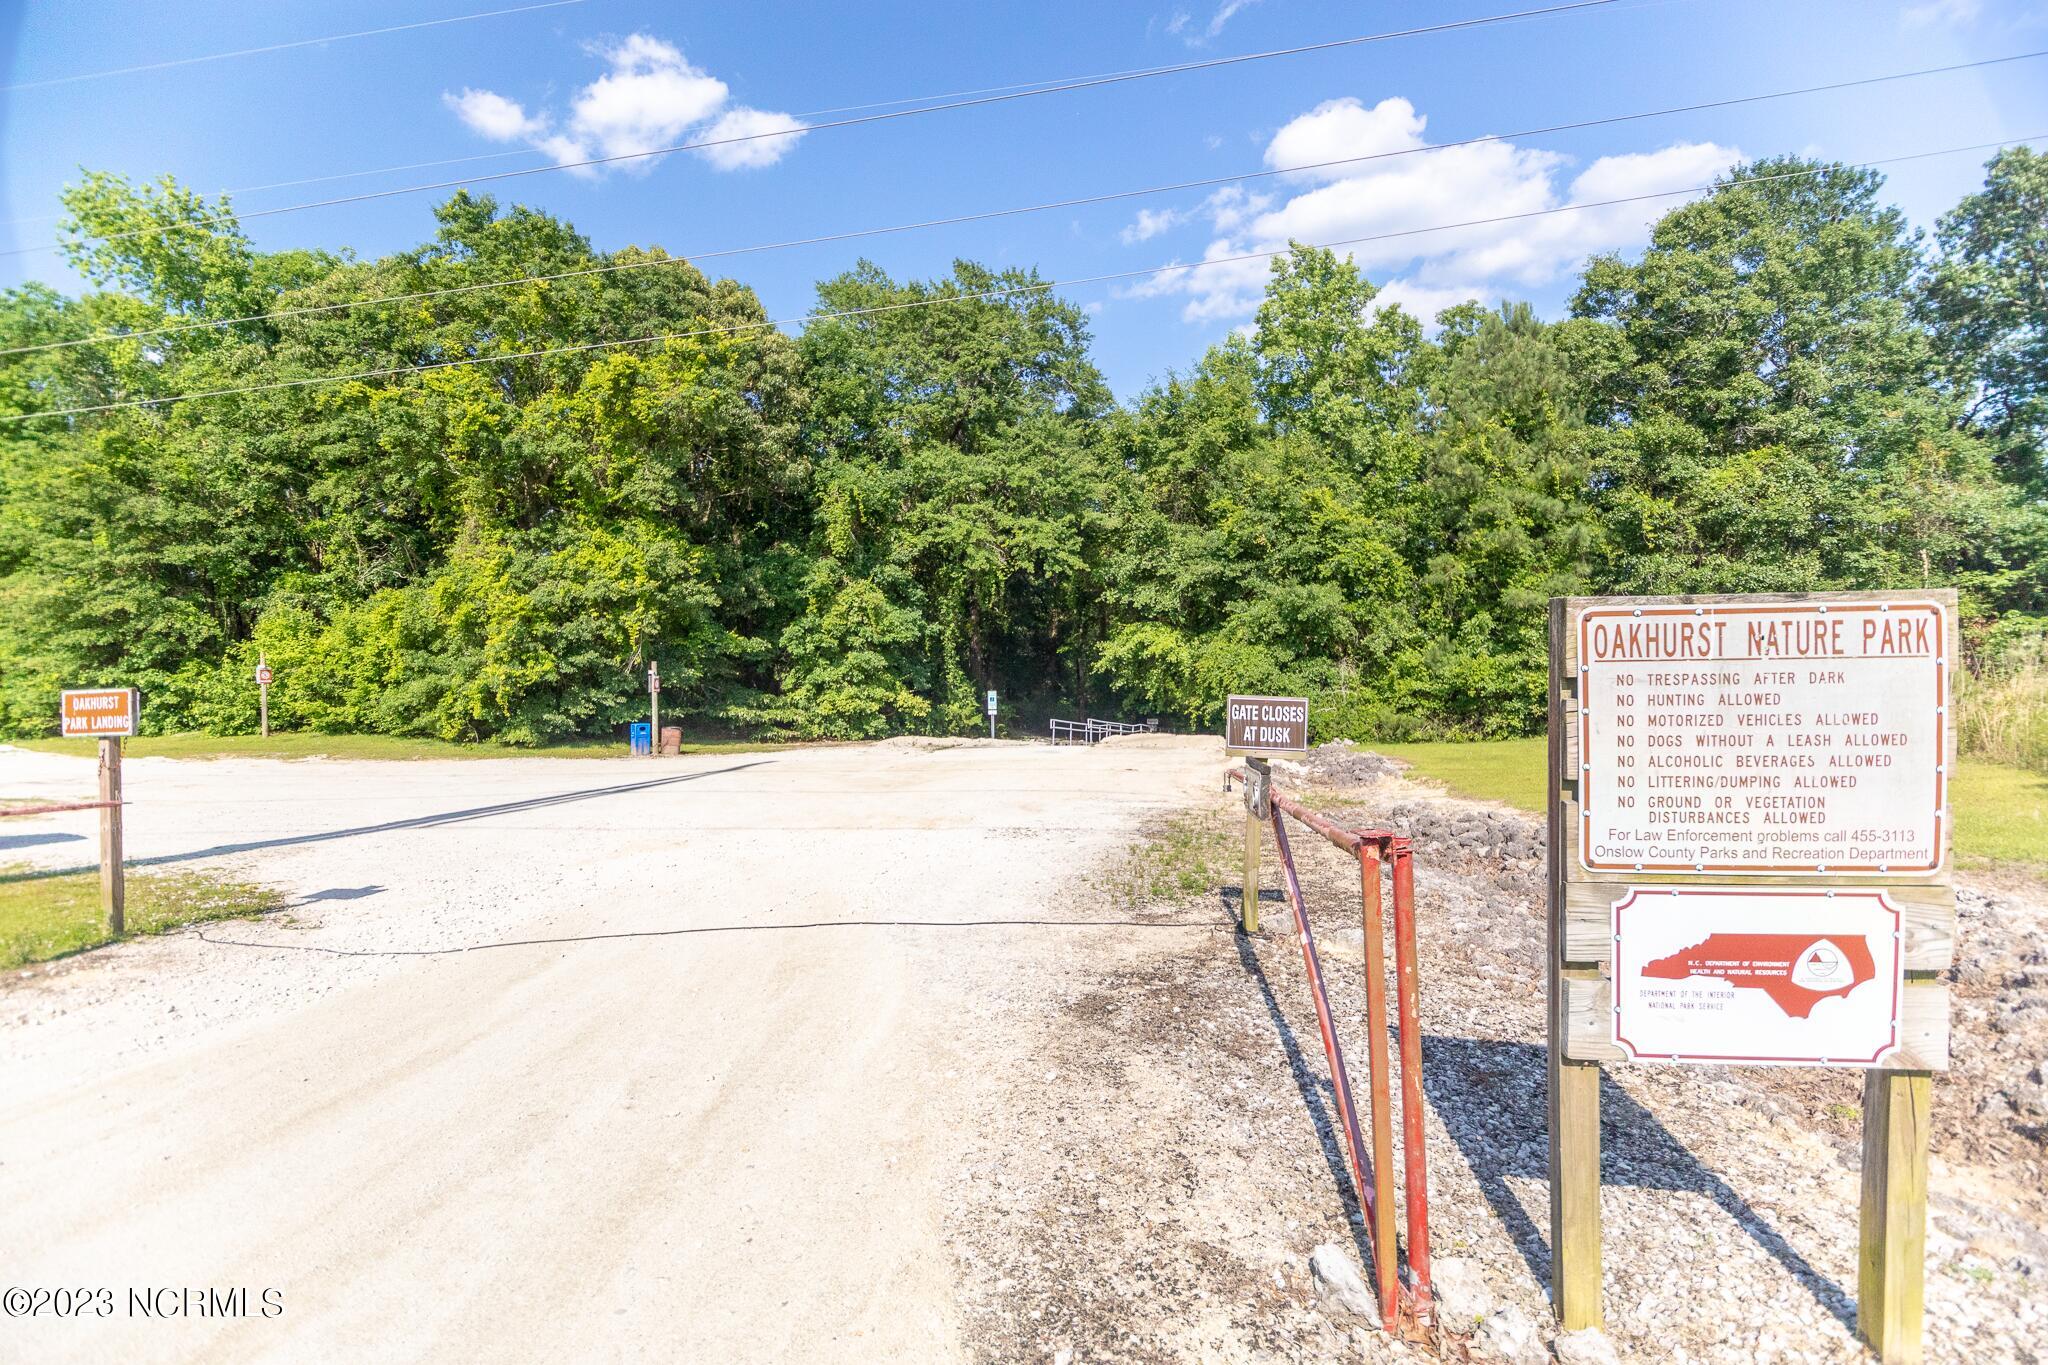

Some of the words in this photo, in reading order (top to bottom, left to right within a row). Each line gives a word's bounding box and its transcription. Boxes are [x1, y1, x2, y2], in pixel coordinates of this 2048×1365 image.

[1594, 622, 1727, 659] OAKHURST
[1748, 619, 1844, 656] NATURE
[1863, 618, 1930, 655] PARK
[1616, 674, 1634, 686] NO
[1647, 673, 1740, 686] TRESPASSING
[1754, 672, 1796, 685] AFTER
[1809, 671, 1846, 684] DARK
[72, 696, 119, 711] OAKHURST
[1616, 694, 1635, 707] NO
[1647, 694, 1705, 706] HUNTING
[1718, 693, 1781, 706] ALLOWED
[1231, 704, 1259, 720] GATE
[1261, 705, 1305, 723] CLOSES
[1617, 715, 1635, 727] NO
[1647, 714, 1724, 727] MOTORIZED
[1737, 713, 1802, 726] VEHICLES
[1816, 712, 1879, 725] ALLOWED
[64, 716, 88, 730] PARK
[91, 715, 129, 730] LANDING
[1243, 726, 1258, 742] AT
[1260, 726, 1291, 743] DUSK
[1617, 735, 1635, 748] NO
[1648, 735, 1683, 747] DOGS
[1696, 734, 1753, 747] WITHOUT
[1766, 734, 1774, 747] A
[1788, 734, 1831, 747] LEASH
[1845, 733, 1908, 746] ALLOWED
[1617, 755, 1635, 768] NO
[1648, 755, 1723, 768] ALCOHOLIC
[1736, 755, 1815, 768] BEVERAGES
[1829, 755, 1892, 767] ALLOWED
[1617, 776, 1635, 788] NO
[1648, 775, 1781, 788] LITTERING/DUMPING
[1794, 775, 1857, 788] ALLOWED
[1617, 796, 1635, 809] NO
[1648, 796, 1701, 808] GROUND
[1715, 796, 1732, 808] OR
[1746, 796, 1826, 809] VEGETATION
[1649, 811, 1750, 824] DISTURBANCES
[1763, 811, 1826, 824] ALLOWED
[1608, 828, 1631, 841] For
[1635, 828, 1662, 841] Law
[1667, 829, 1753, 842] Enforcement
[1823, 830, 1847, 842] call
[1851, 829, 1915, 842] 455-3113
[1594, 845, 1644, 858] Onslow
[1649, 846, 1695, 861] County
[1700, 846, 1738, 858] Parks
[1742, 846, 1767, 859] and
[1772, 847, 1844, 860] Recreation
[1849, 847, 1928, 862] Department
[1640, 990, 1676, 998] DEPARTMENT
[1680, 990, 1689, 998] OF
[1692, 990, 1703, 998] THE
[1707, 991, 1735, 999] INTERIOR
[1680, 1002, 1695, 1010] PARK
[1698, 1003, 1723, 1011] SERVICE
